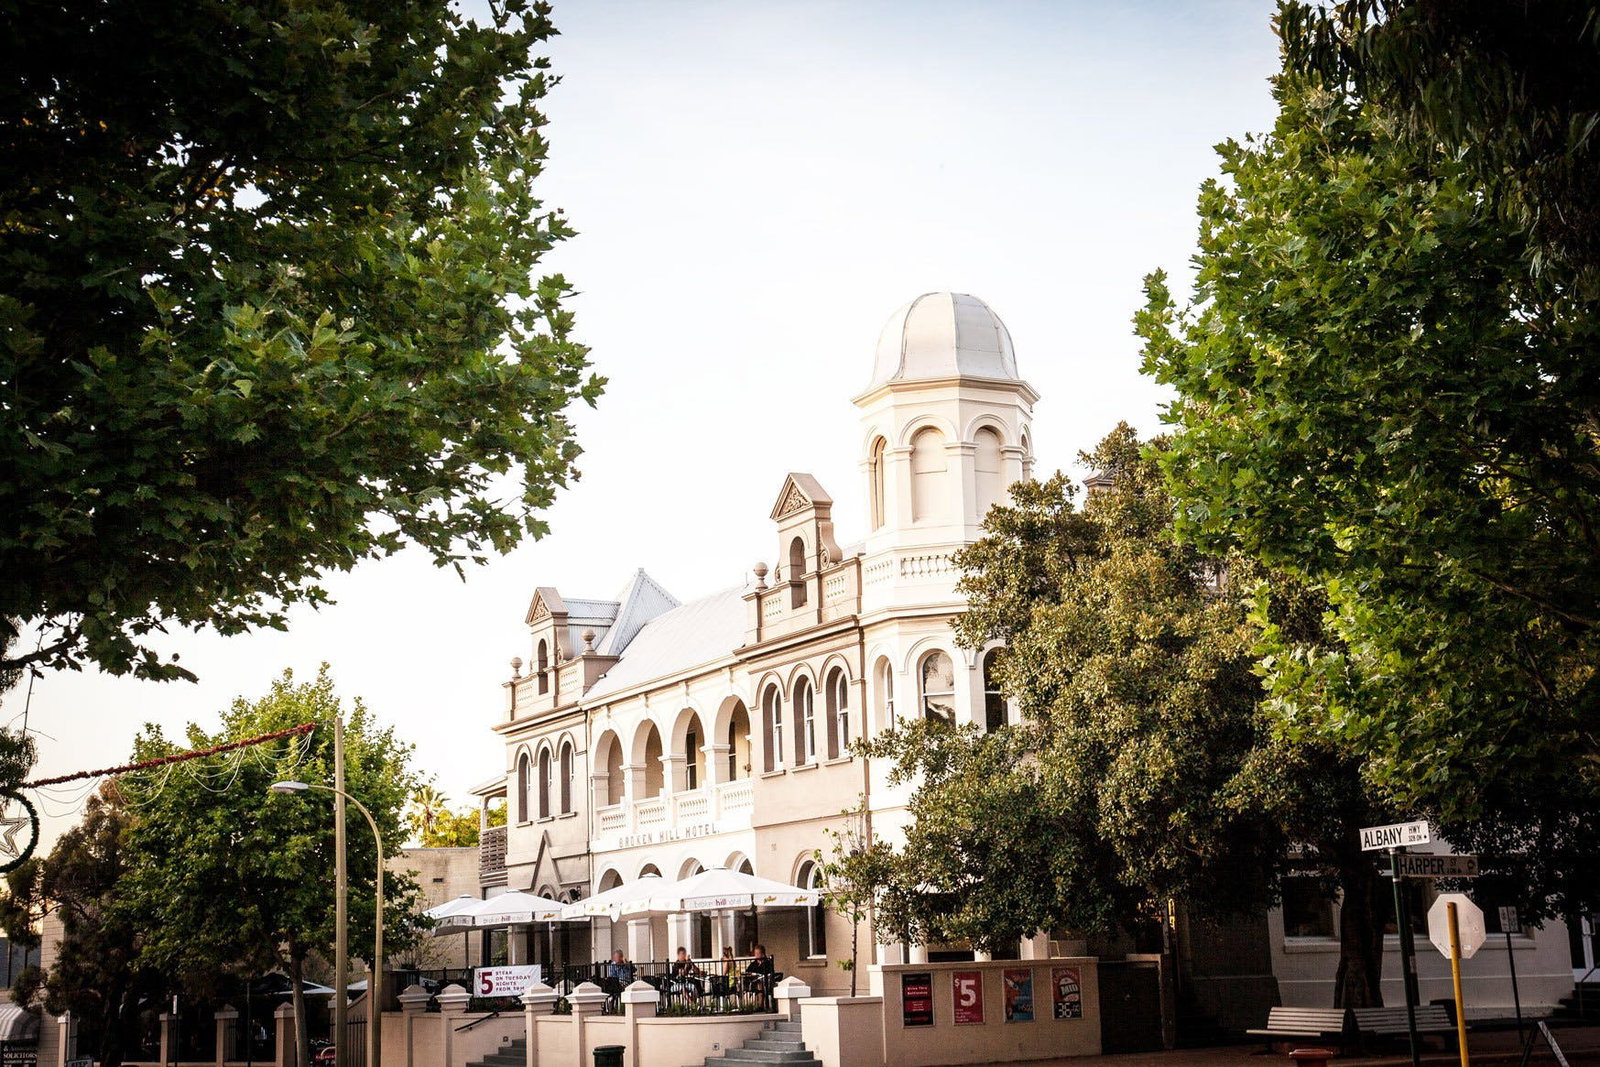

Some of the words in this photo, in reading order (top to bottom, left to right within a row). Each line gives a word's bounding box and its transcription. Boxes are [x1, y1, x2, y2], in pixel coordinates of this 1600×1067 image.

[619, 832, 653, 848] BROKEN
[659, 828, 680, 842] HILL
[1364, 827, 1403, 848] ALBANY
[1408, 825, 1421, 834] HWY
[1399, 858, 1444, 875] HARPER
[716, 898, 727, 907] hill
[478, 971, 493, 995] $5
[954, 978, 977, 1007] $5
